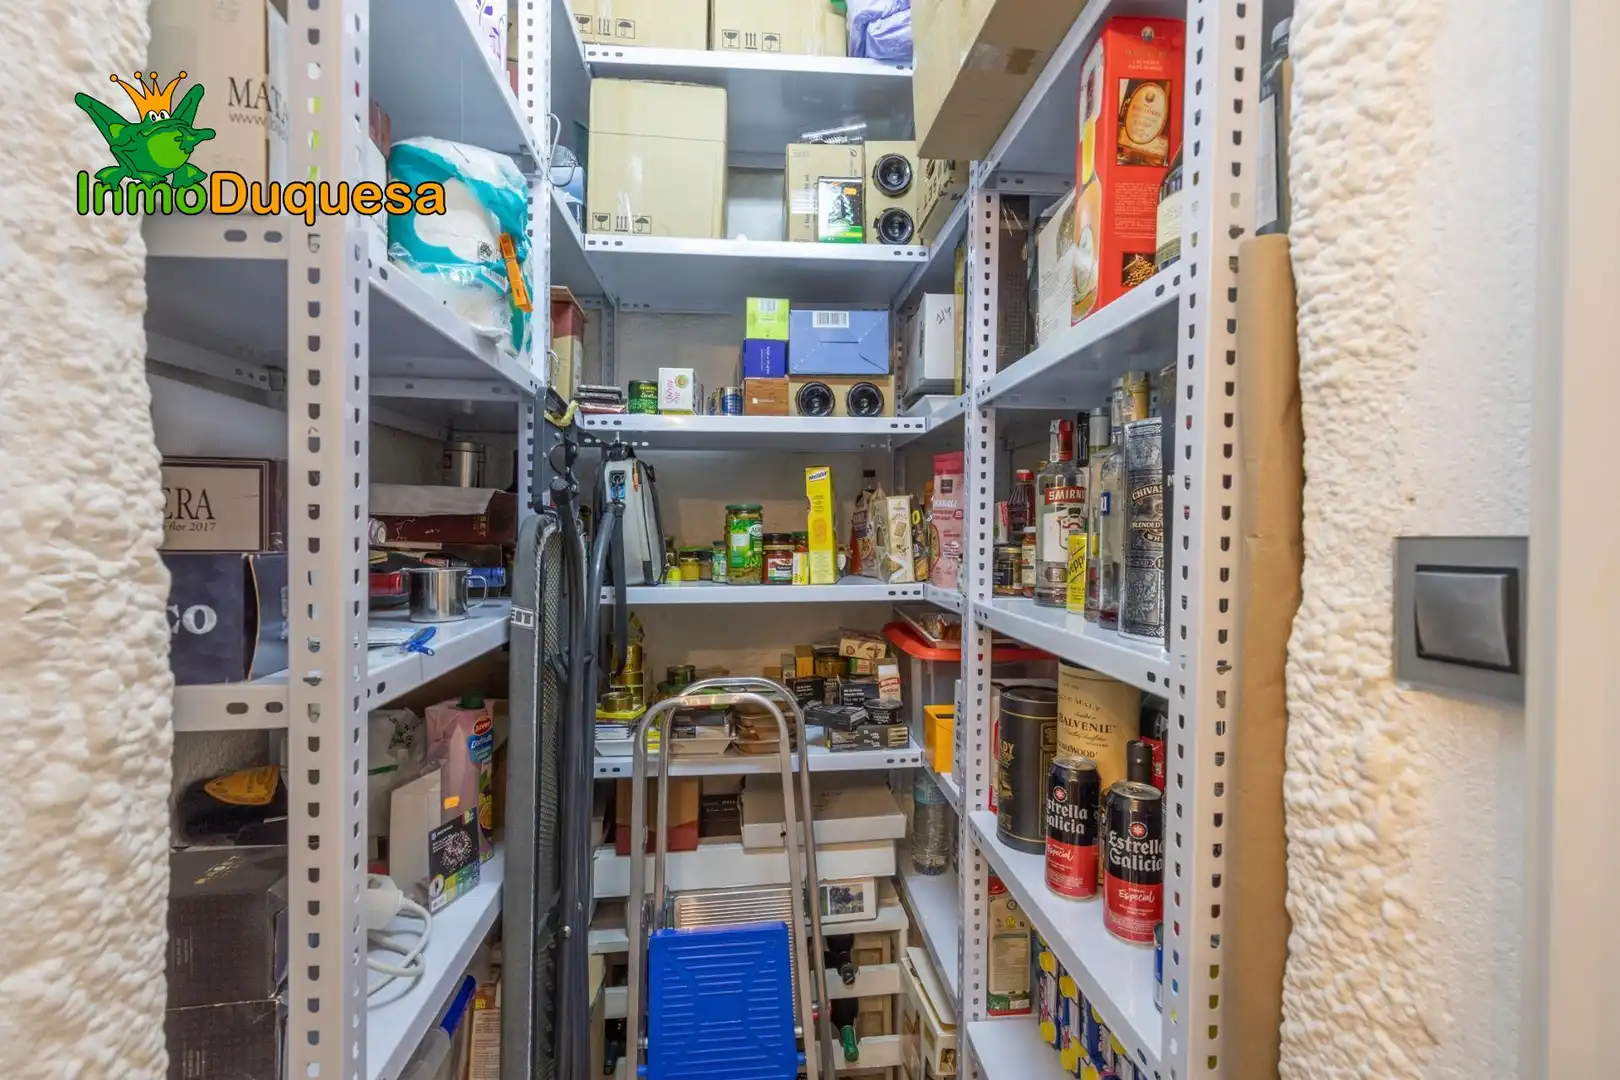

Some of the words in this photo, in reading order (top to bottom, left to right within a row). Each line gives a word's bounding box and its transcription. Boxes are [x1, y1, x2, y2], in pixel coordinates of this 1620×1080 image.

[1048, 489, 1086, 501] SMIRN
[1046, 798, 1088, 820] strella
[1046, 814, 1085, 835] alicia
